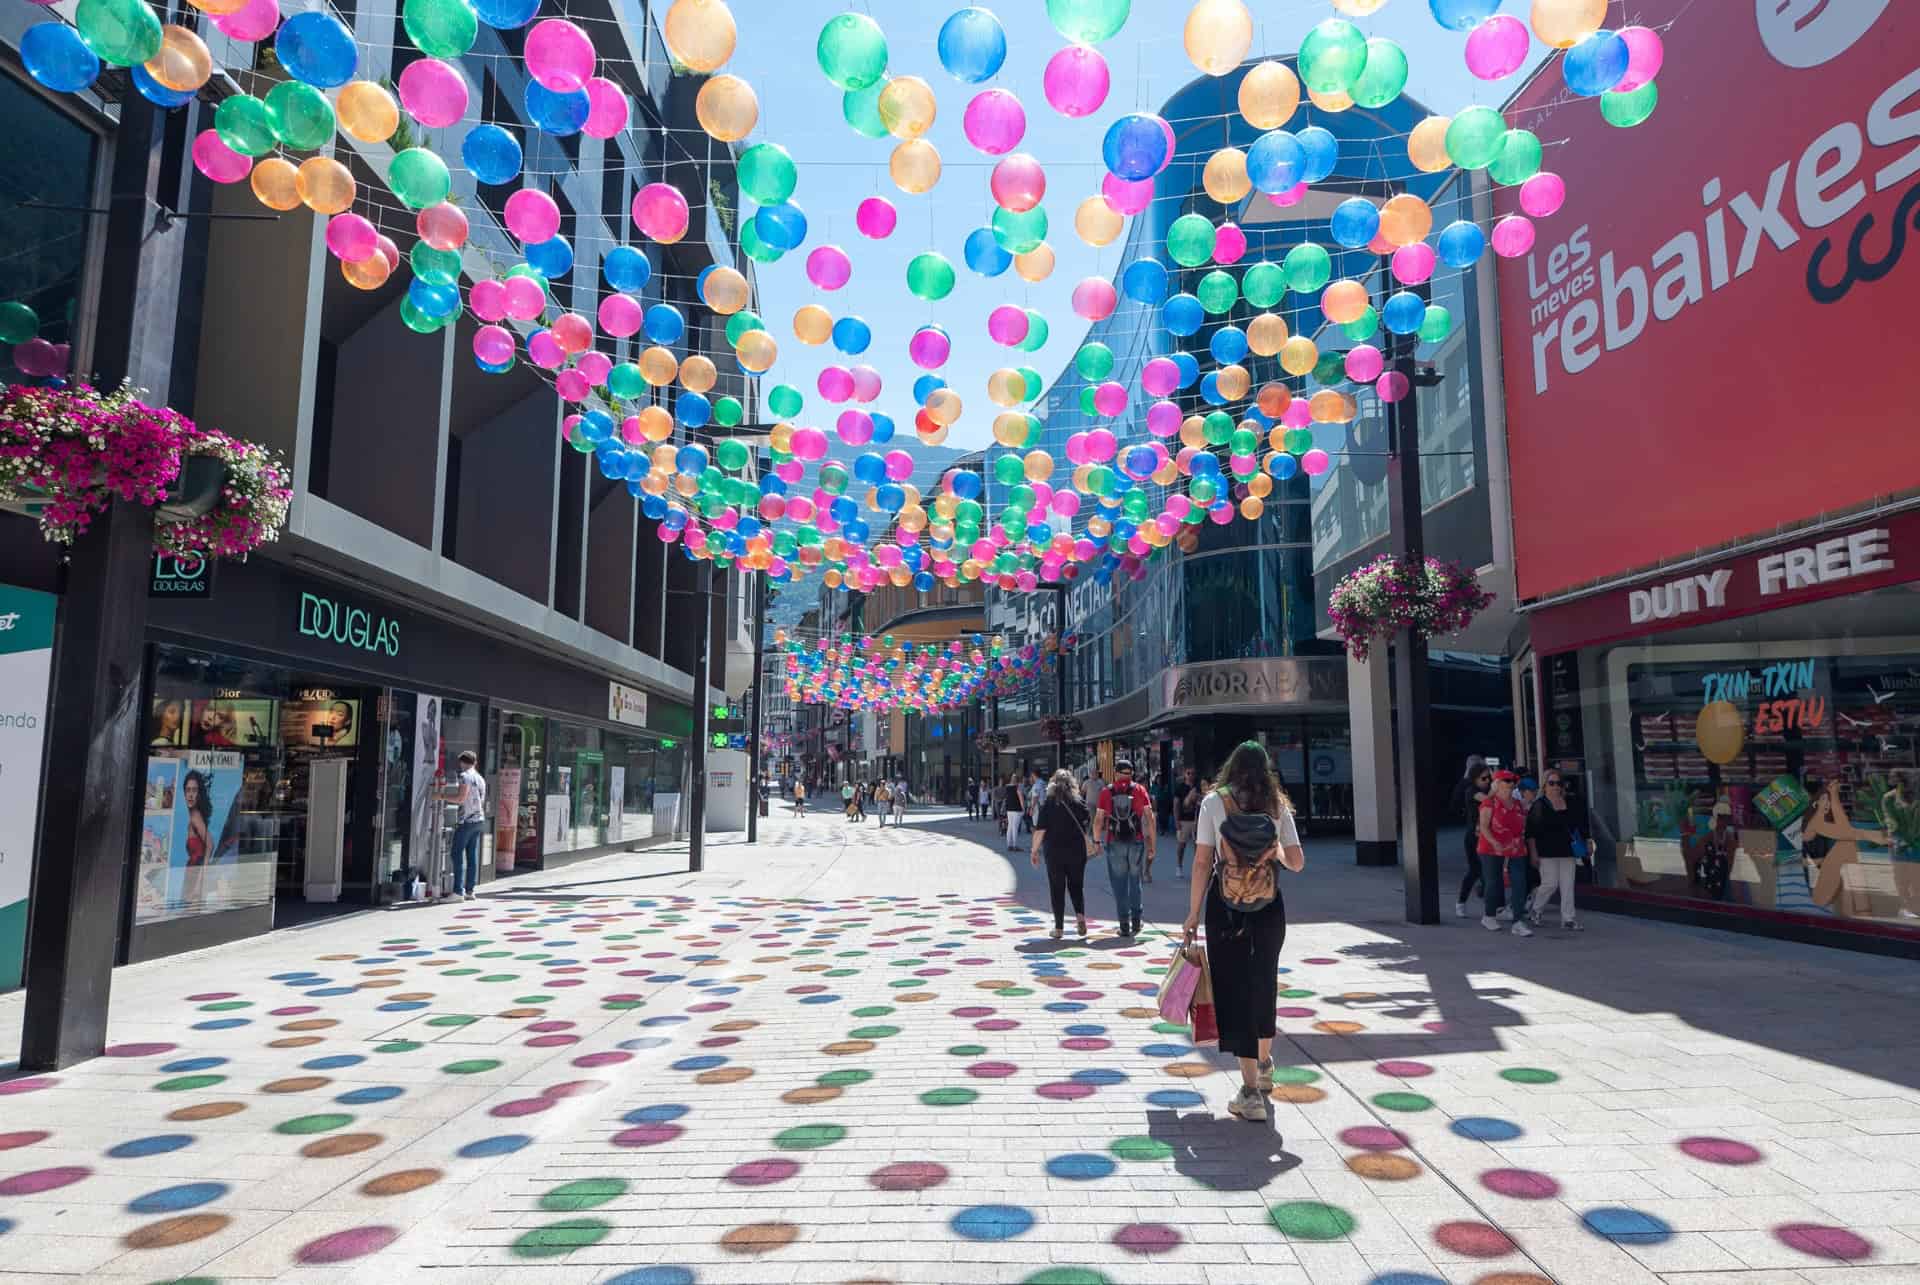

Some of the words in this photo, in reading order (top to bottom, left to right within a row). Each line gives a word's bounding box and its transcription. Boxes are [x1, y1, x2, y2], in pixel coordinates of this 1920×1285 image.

[1527, 223, 1592, 299] Les
[1531, 66, 1920, 395] rebaixes
[1530, 266, 1596, 327] meves
[152, 580, 206, 592] DOUGLAS
[1628, 569, 1731, 625] DUTY
[1758, 528, 1891, 595] FREE
[299, 591, 400, 657] DOUGLAS
[216, 688, 241, 698] Dior
[1702, 670, 1750, 705] TXIN
[1761, 657, 1815, 698] TXIN
[1754, 695, 1825, 735] ESTIU
[527, 744, 544, 838] Farmacia
